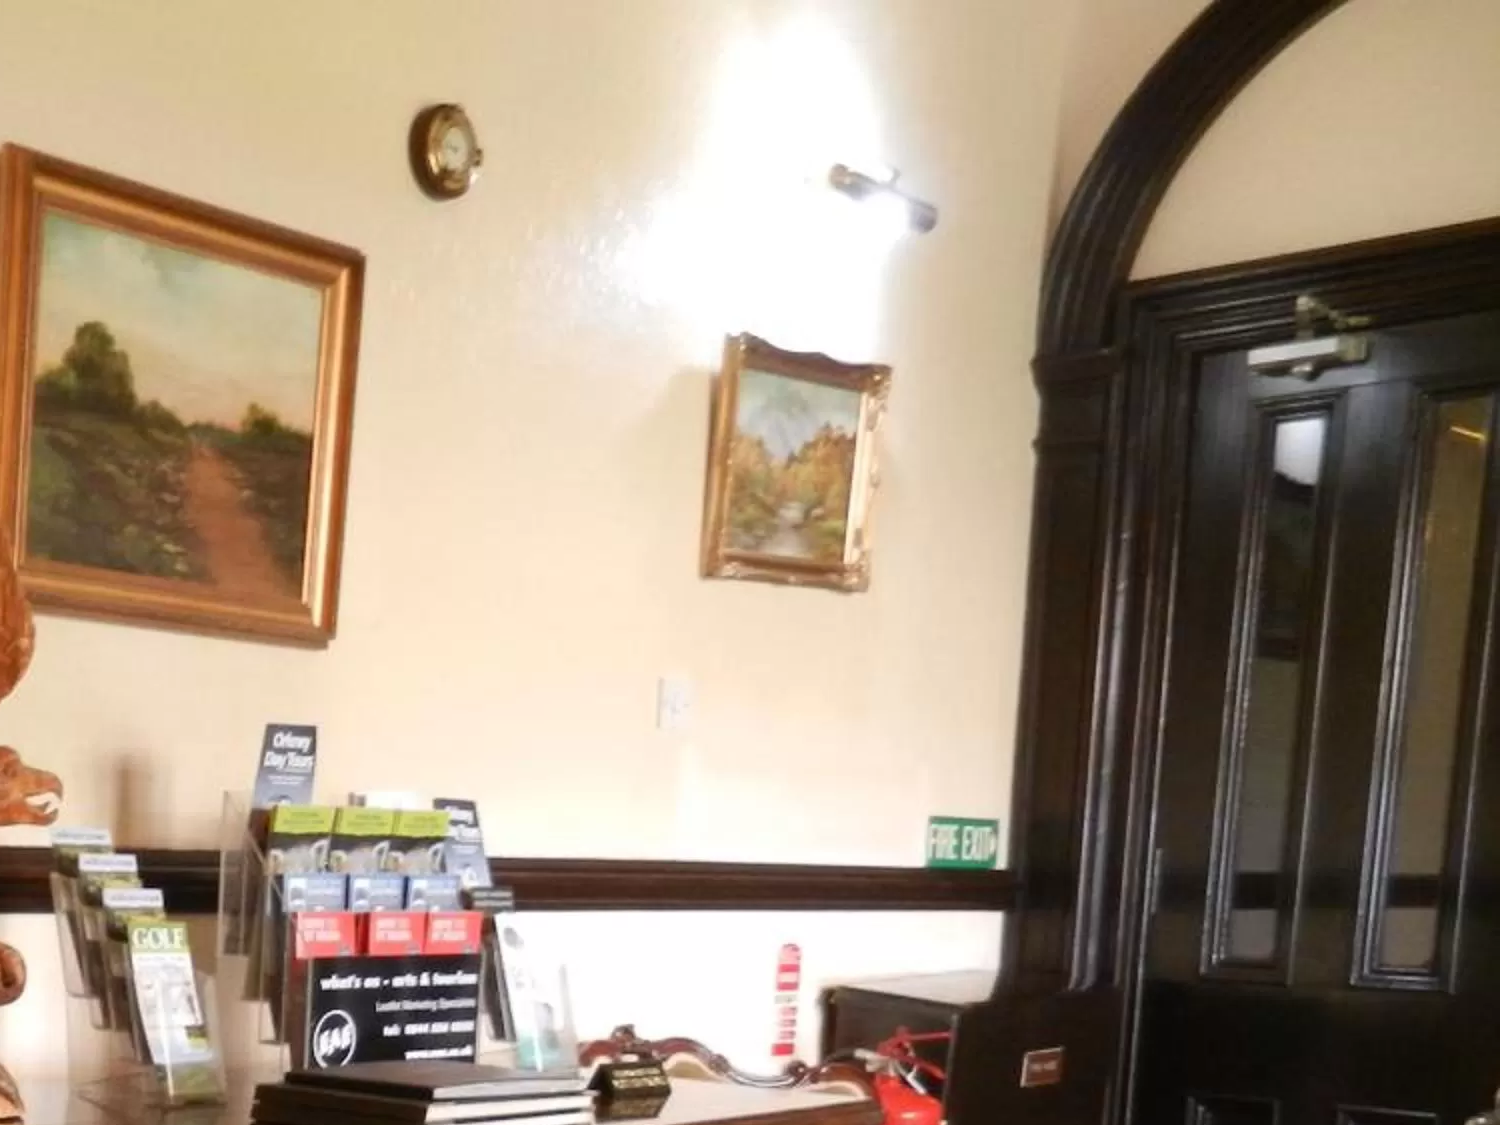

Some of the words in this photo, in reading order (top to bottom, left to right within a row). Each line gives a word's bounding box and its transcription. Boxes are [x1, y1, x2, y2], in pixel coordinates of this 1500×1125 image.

[928, 823, 959, 860] FIRE
[961, 825, 994, 862] EXIT
[132, 927, 184, 951] GOLF
[320, 973, 362, 991] what's
